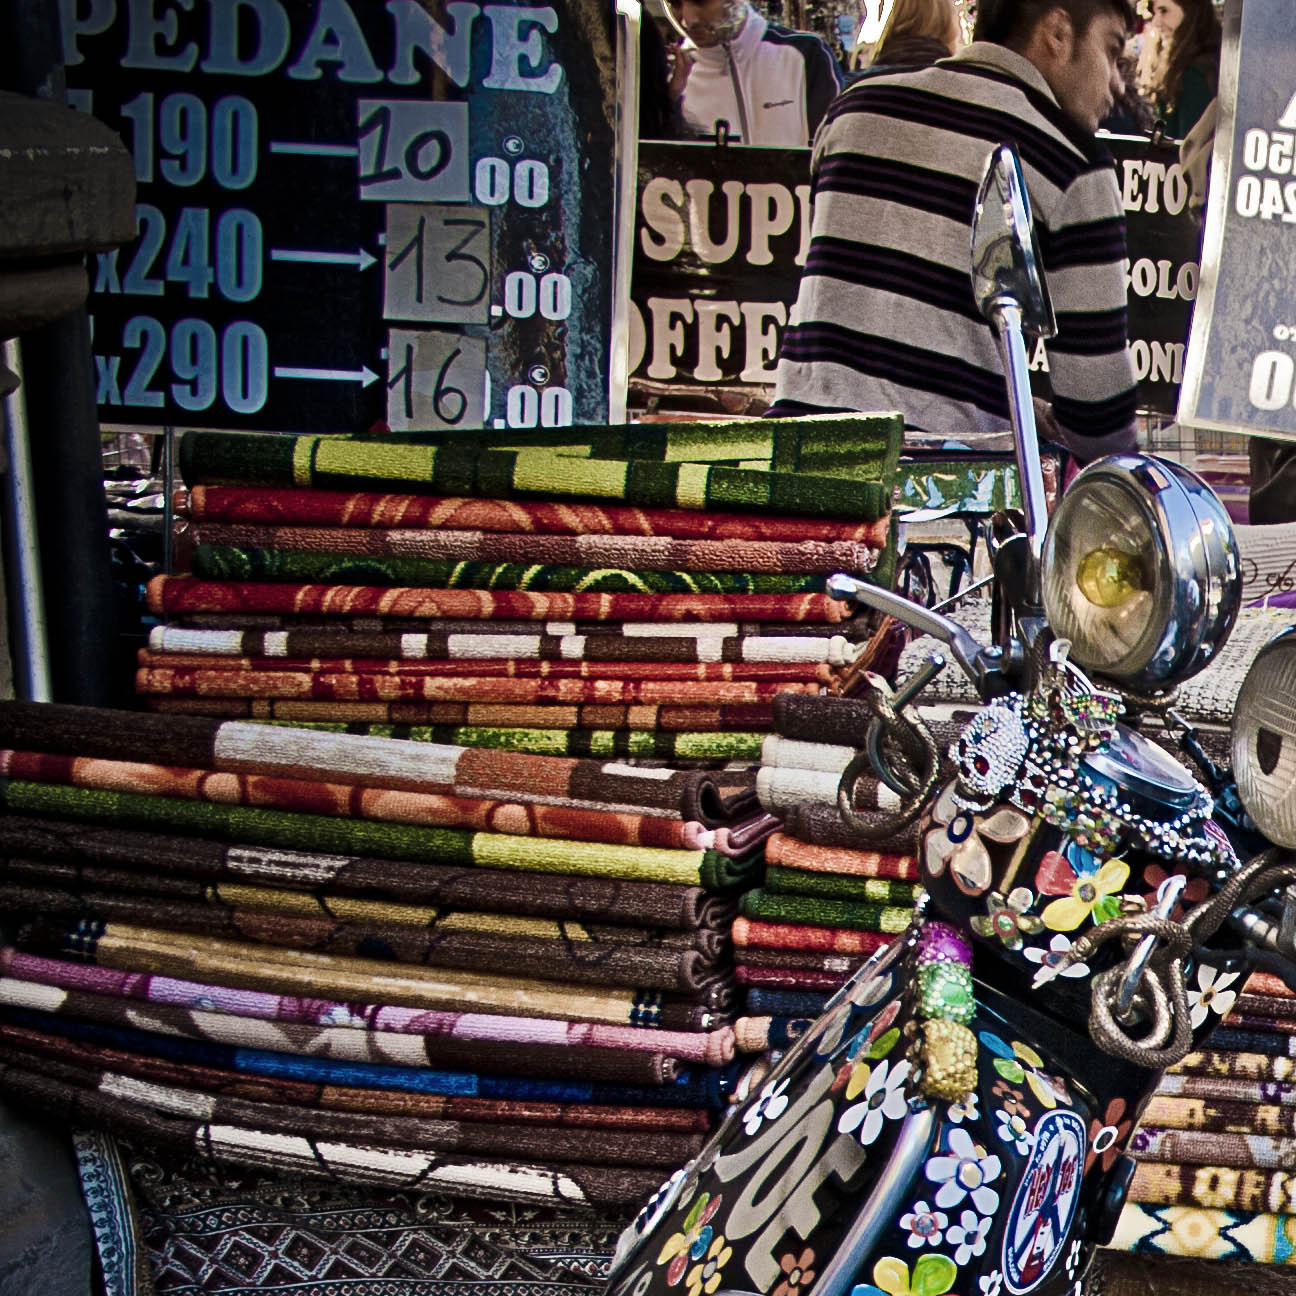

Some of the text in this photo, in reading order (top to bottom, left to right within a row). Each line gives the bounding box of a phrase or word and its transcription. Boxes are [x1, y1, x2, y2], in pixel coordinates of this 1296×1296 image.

[62, 0, 563, 93] PEDANE
[67, 88, 259, 191] 190
[356, 104, 455, 186] 10
[1120, 159, 1188, 216] ETO
[83, 203, 264, 303] x240
[388, 215, 489, 306] 13
[1126, 257, 1201, 301] OLO
[88, 315, 269, 415] x290
[388, 346, 468, 427] 16
[629, 298, 800, 384] FFE
[715, 1064, 868, 1292] JOE
